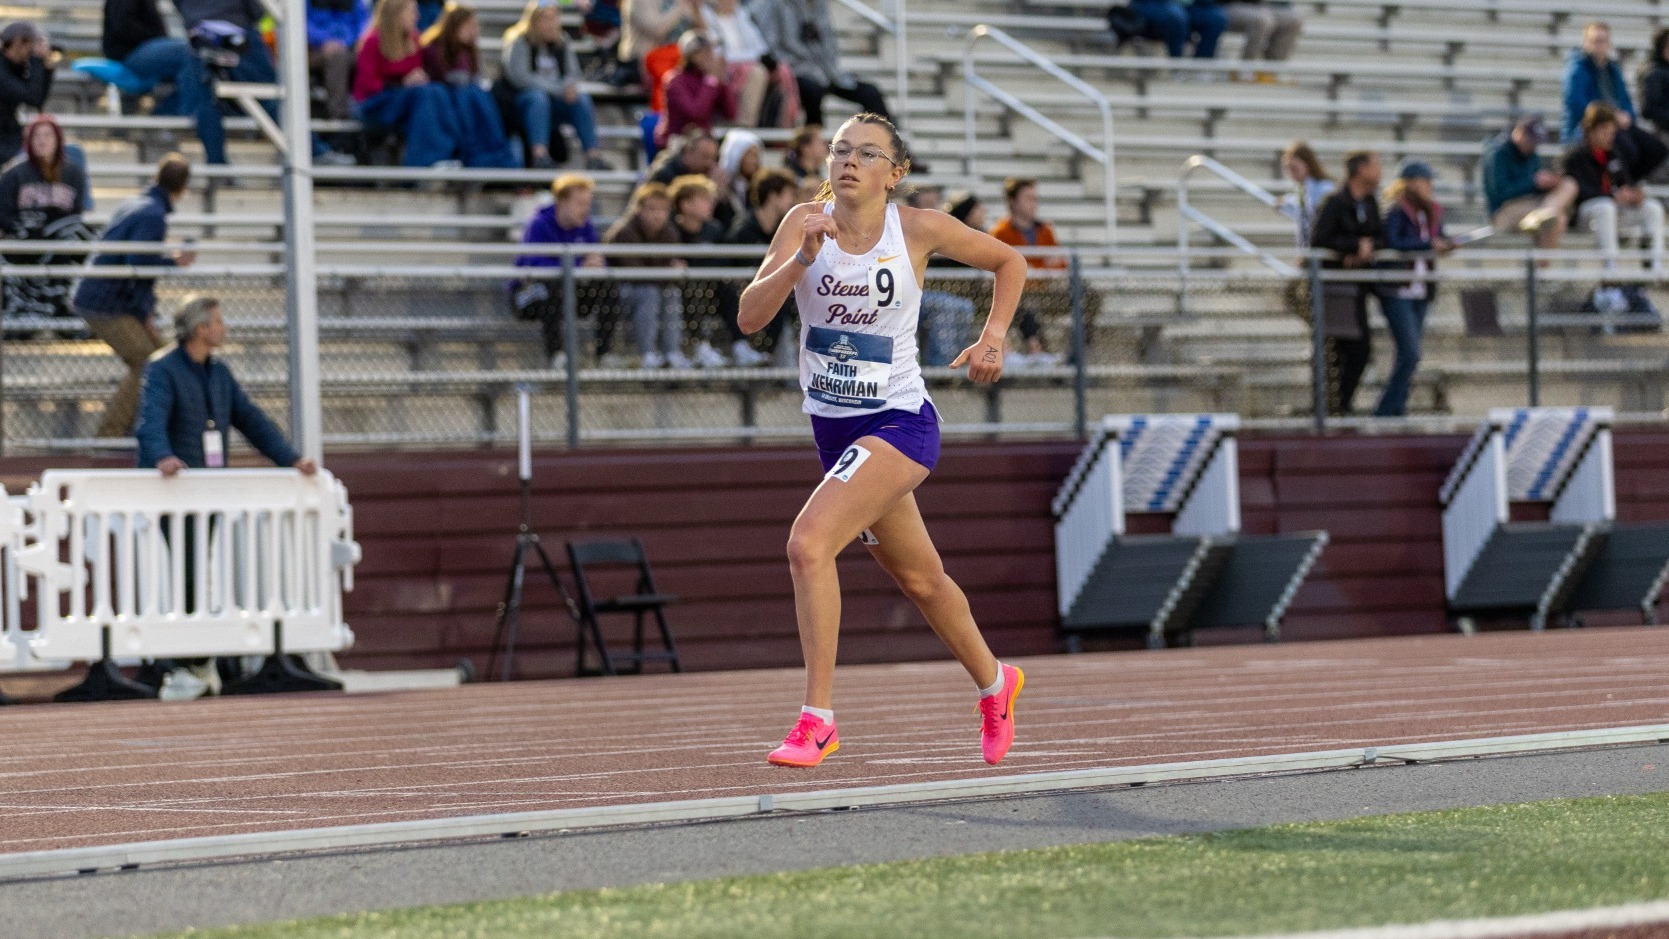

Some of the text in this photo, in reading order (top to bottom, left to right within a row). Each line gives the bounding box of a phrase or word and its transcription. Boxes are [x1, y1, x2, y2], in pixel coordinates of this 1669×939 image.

[816, 274, 870, 297] Steve
[875, 268, 895, 307] 9
[825, 304, 879, 325] Point
[827, 362, 857, 378] FAITH
[833, 448, 859, 475] 9
